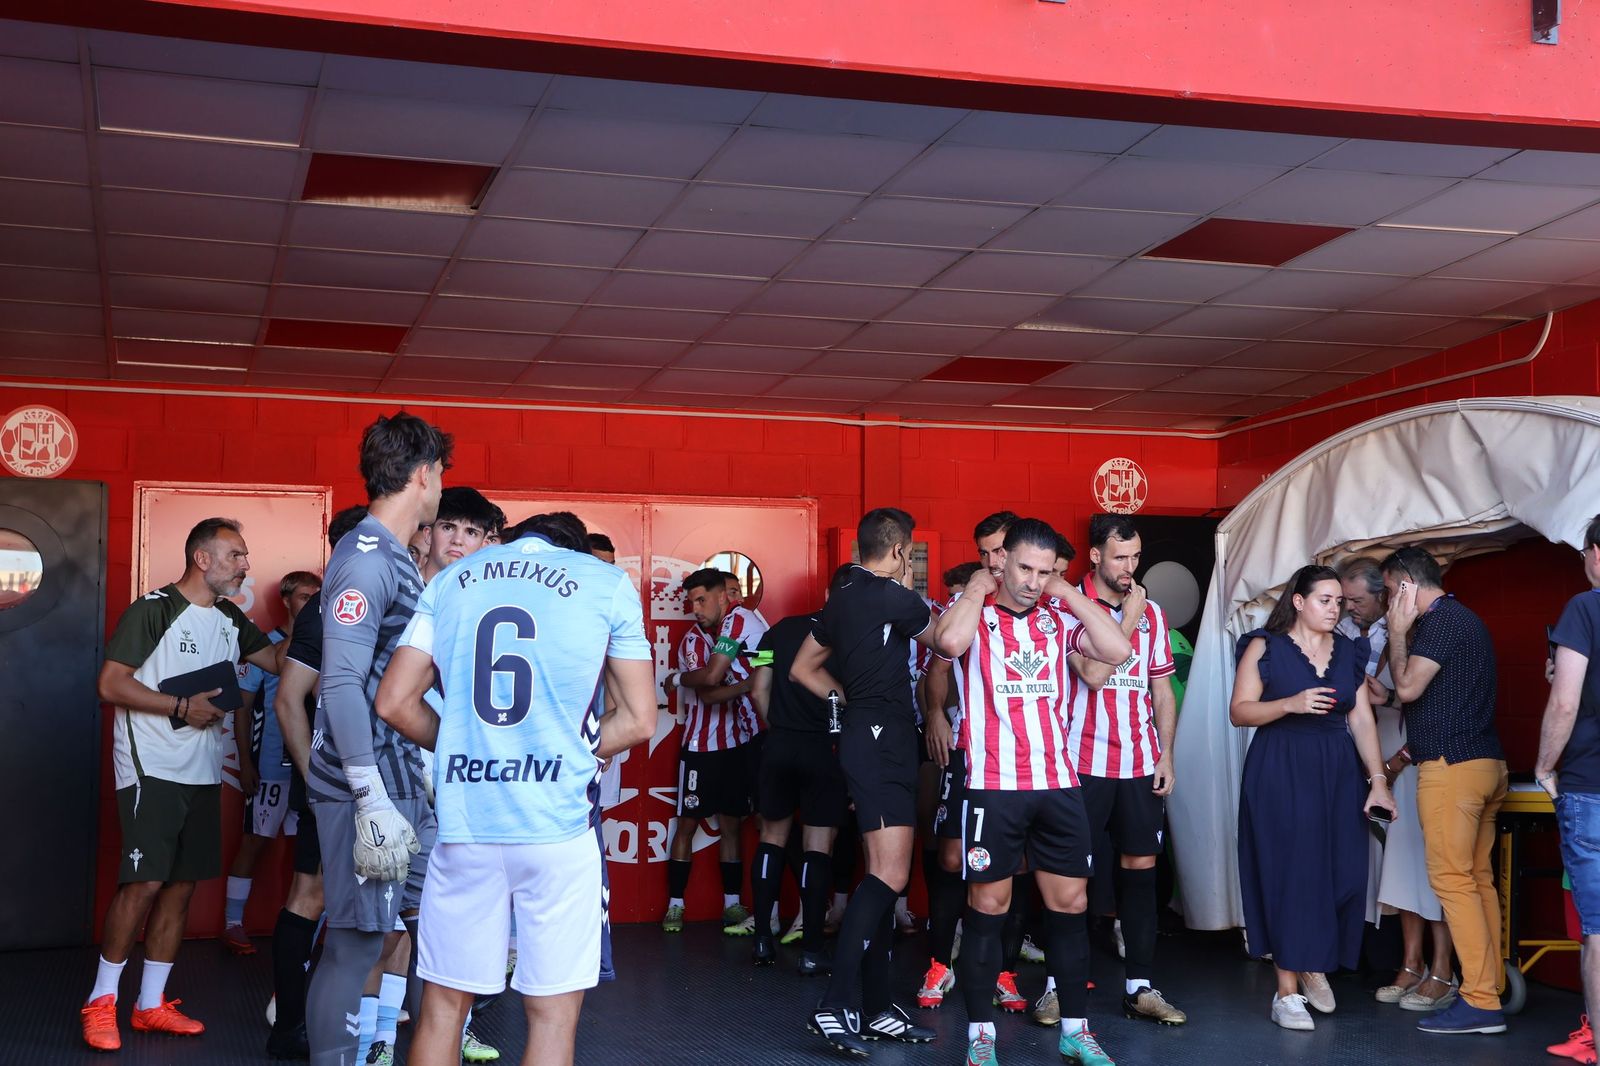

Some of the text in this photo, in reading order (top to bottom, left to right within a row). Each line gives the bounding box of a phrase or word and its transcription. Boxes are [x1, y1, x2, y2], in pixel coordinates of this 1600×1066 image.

[457, 560, 580, 599] P. MEIXÚS
[180, 641, 200, 655] D.S.
[472, 605, 537, 728] 6
[995, 683, 1024, 695] CAJA
[445, 753, 564, 784] Recalvi
[688, 770, 698, 792] 8
[260, 781, 282, 807] 19
[942, 772, 953, 800] 5
